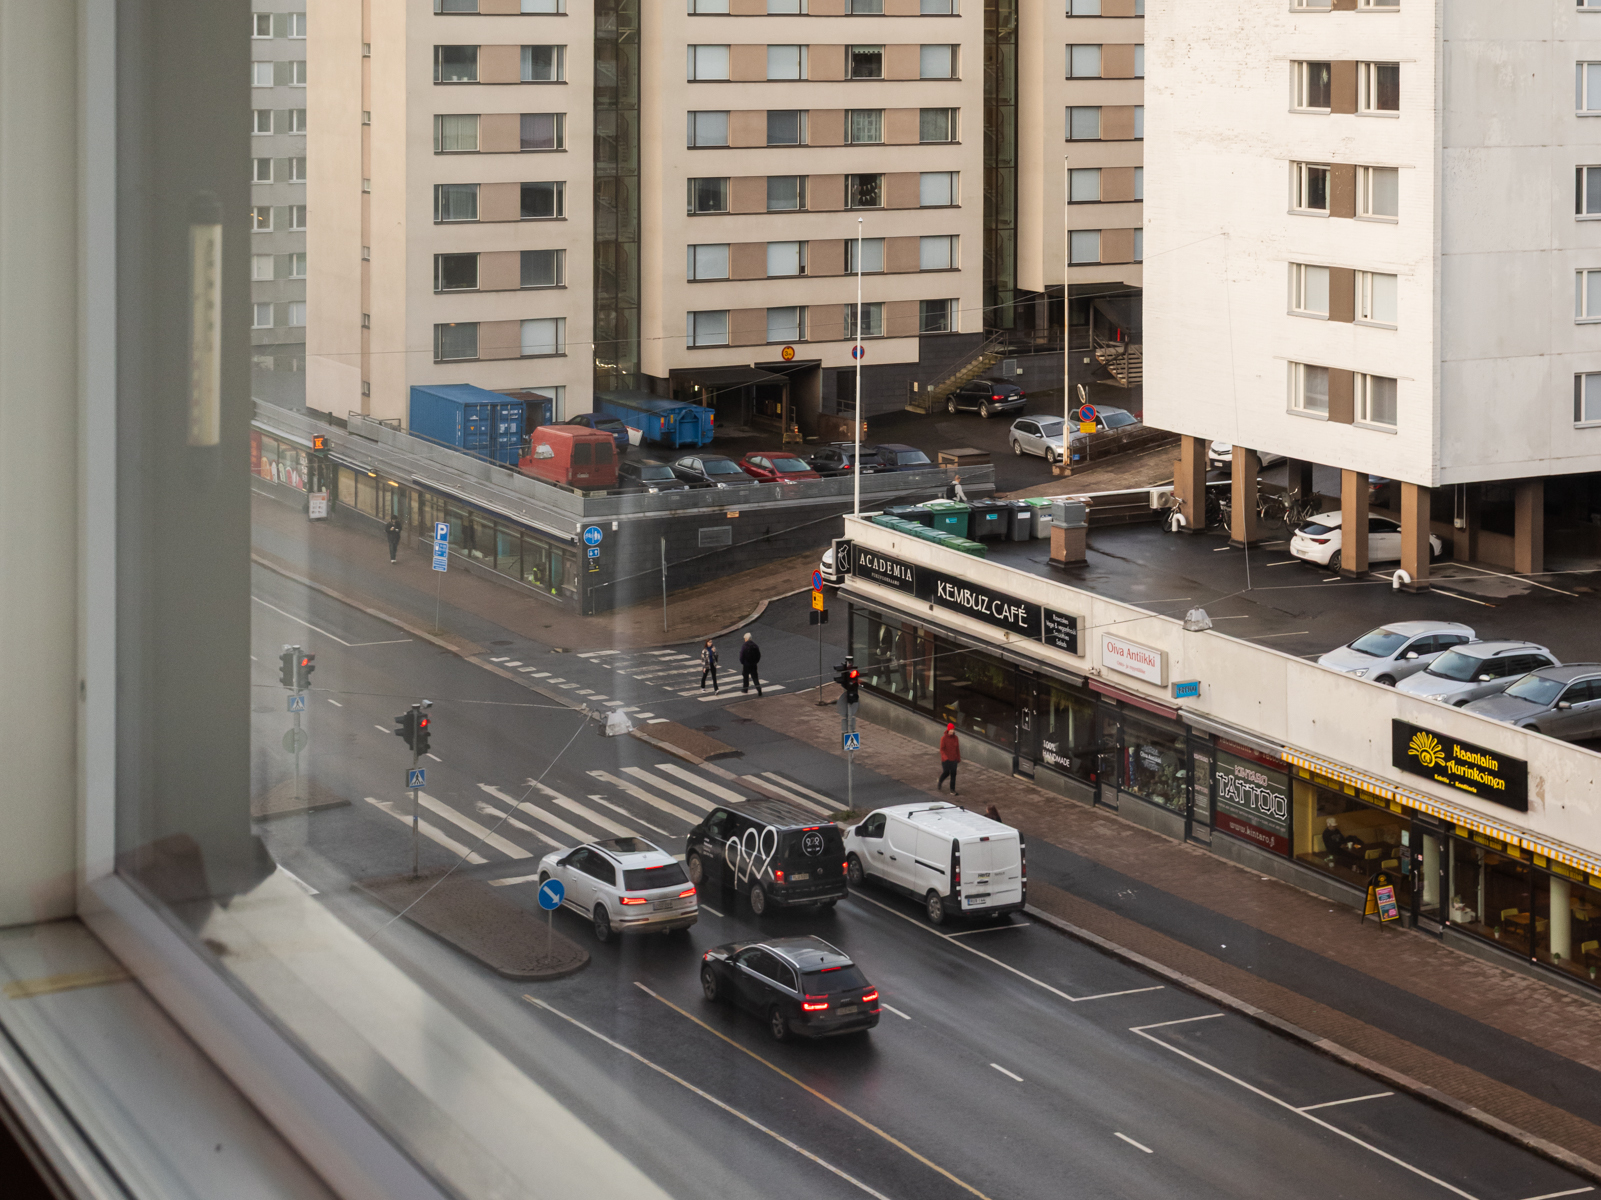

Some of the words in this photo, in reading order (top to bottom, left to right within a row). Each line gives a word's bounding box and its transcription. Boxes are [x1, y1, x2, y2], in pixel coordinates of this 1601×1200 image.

[437, 524, 447, 540] P
[859, 552, 913, 582] ACADEMIA
[937, 580, 991, 615] KEMBUZ
[992, 604, 1028, 628] CAFÉ
[1106, 641, 1125, 657] Oiva
[1125, 648, 1156, 668] Antiikki
[1043, 740, 1057, 752] 100%
[1043, 749, 1071, 768] HANDMADE
[1453, 744, 1498, 771] Naantalin
[1234, 765, 1269, 787] KINTARO
[1446, 760, 1505, 790] Aurinkoinen
[1216, 772, 1288, 820] TATTOO
[1229, 821, 1275, 848] www.kintaro.fi
